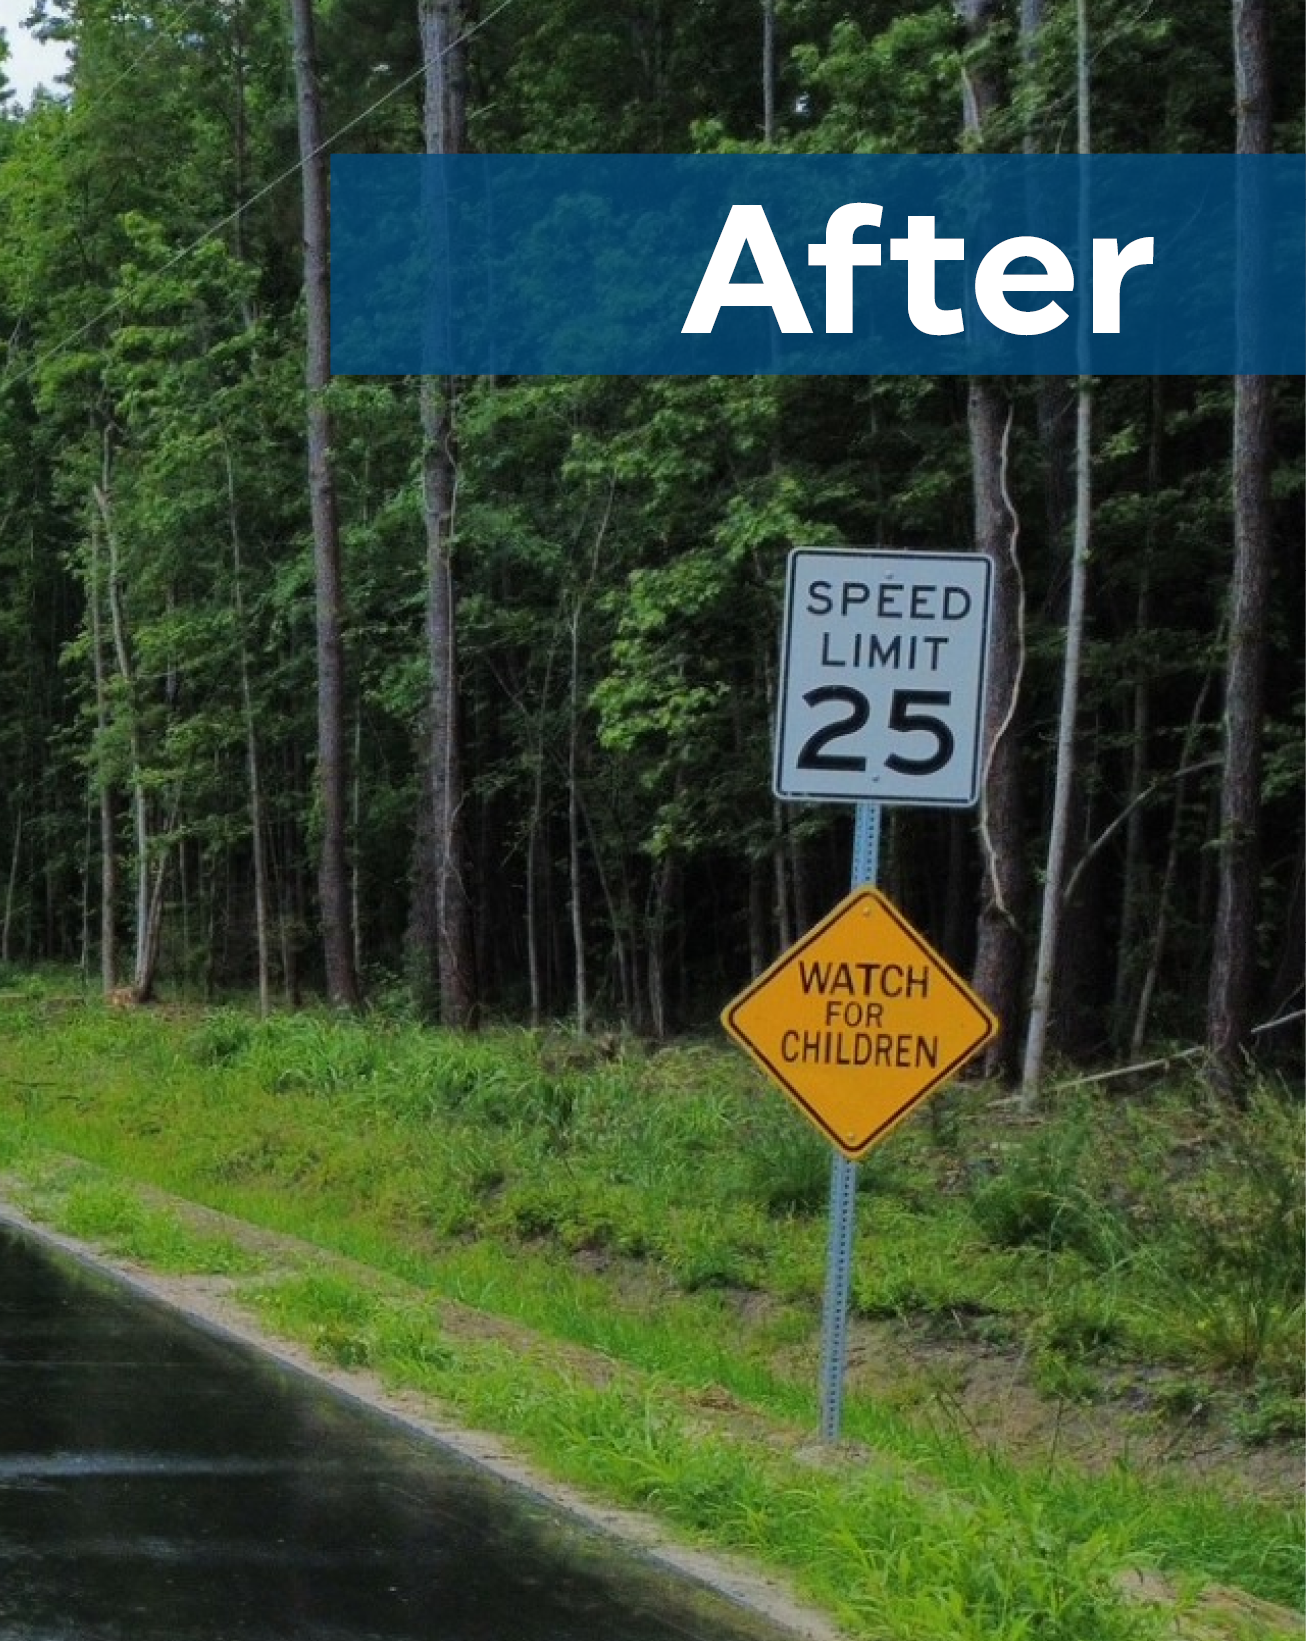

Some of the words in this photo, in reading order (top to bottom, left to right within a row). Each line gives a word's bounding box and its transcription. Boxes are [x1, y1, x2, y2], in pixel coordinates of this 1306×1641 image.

[806, 580, 972, 621] SPEED
[821, 632, 950, 671] LIMIT
[796, 684, 955, 776] 25
[799, 960, 930, 998] WATCH
[825, 1001, 884, 1028] FOR
[781, 1030, 938, 1069] CHILDREN
